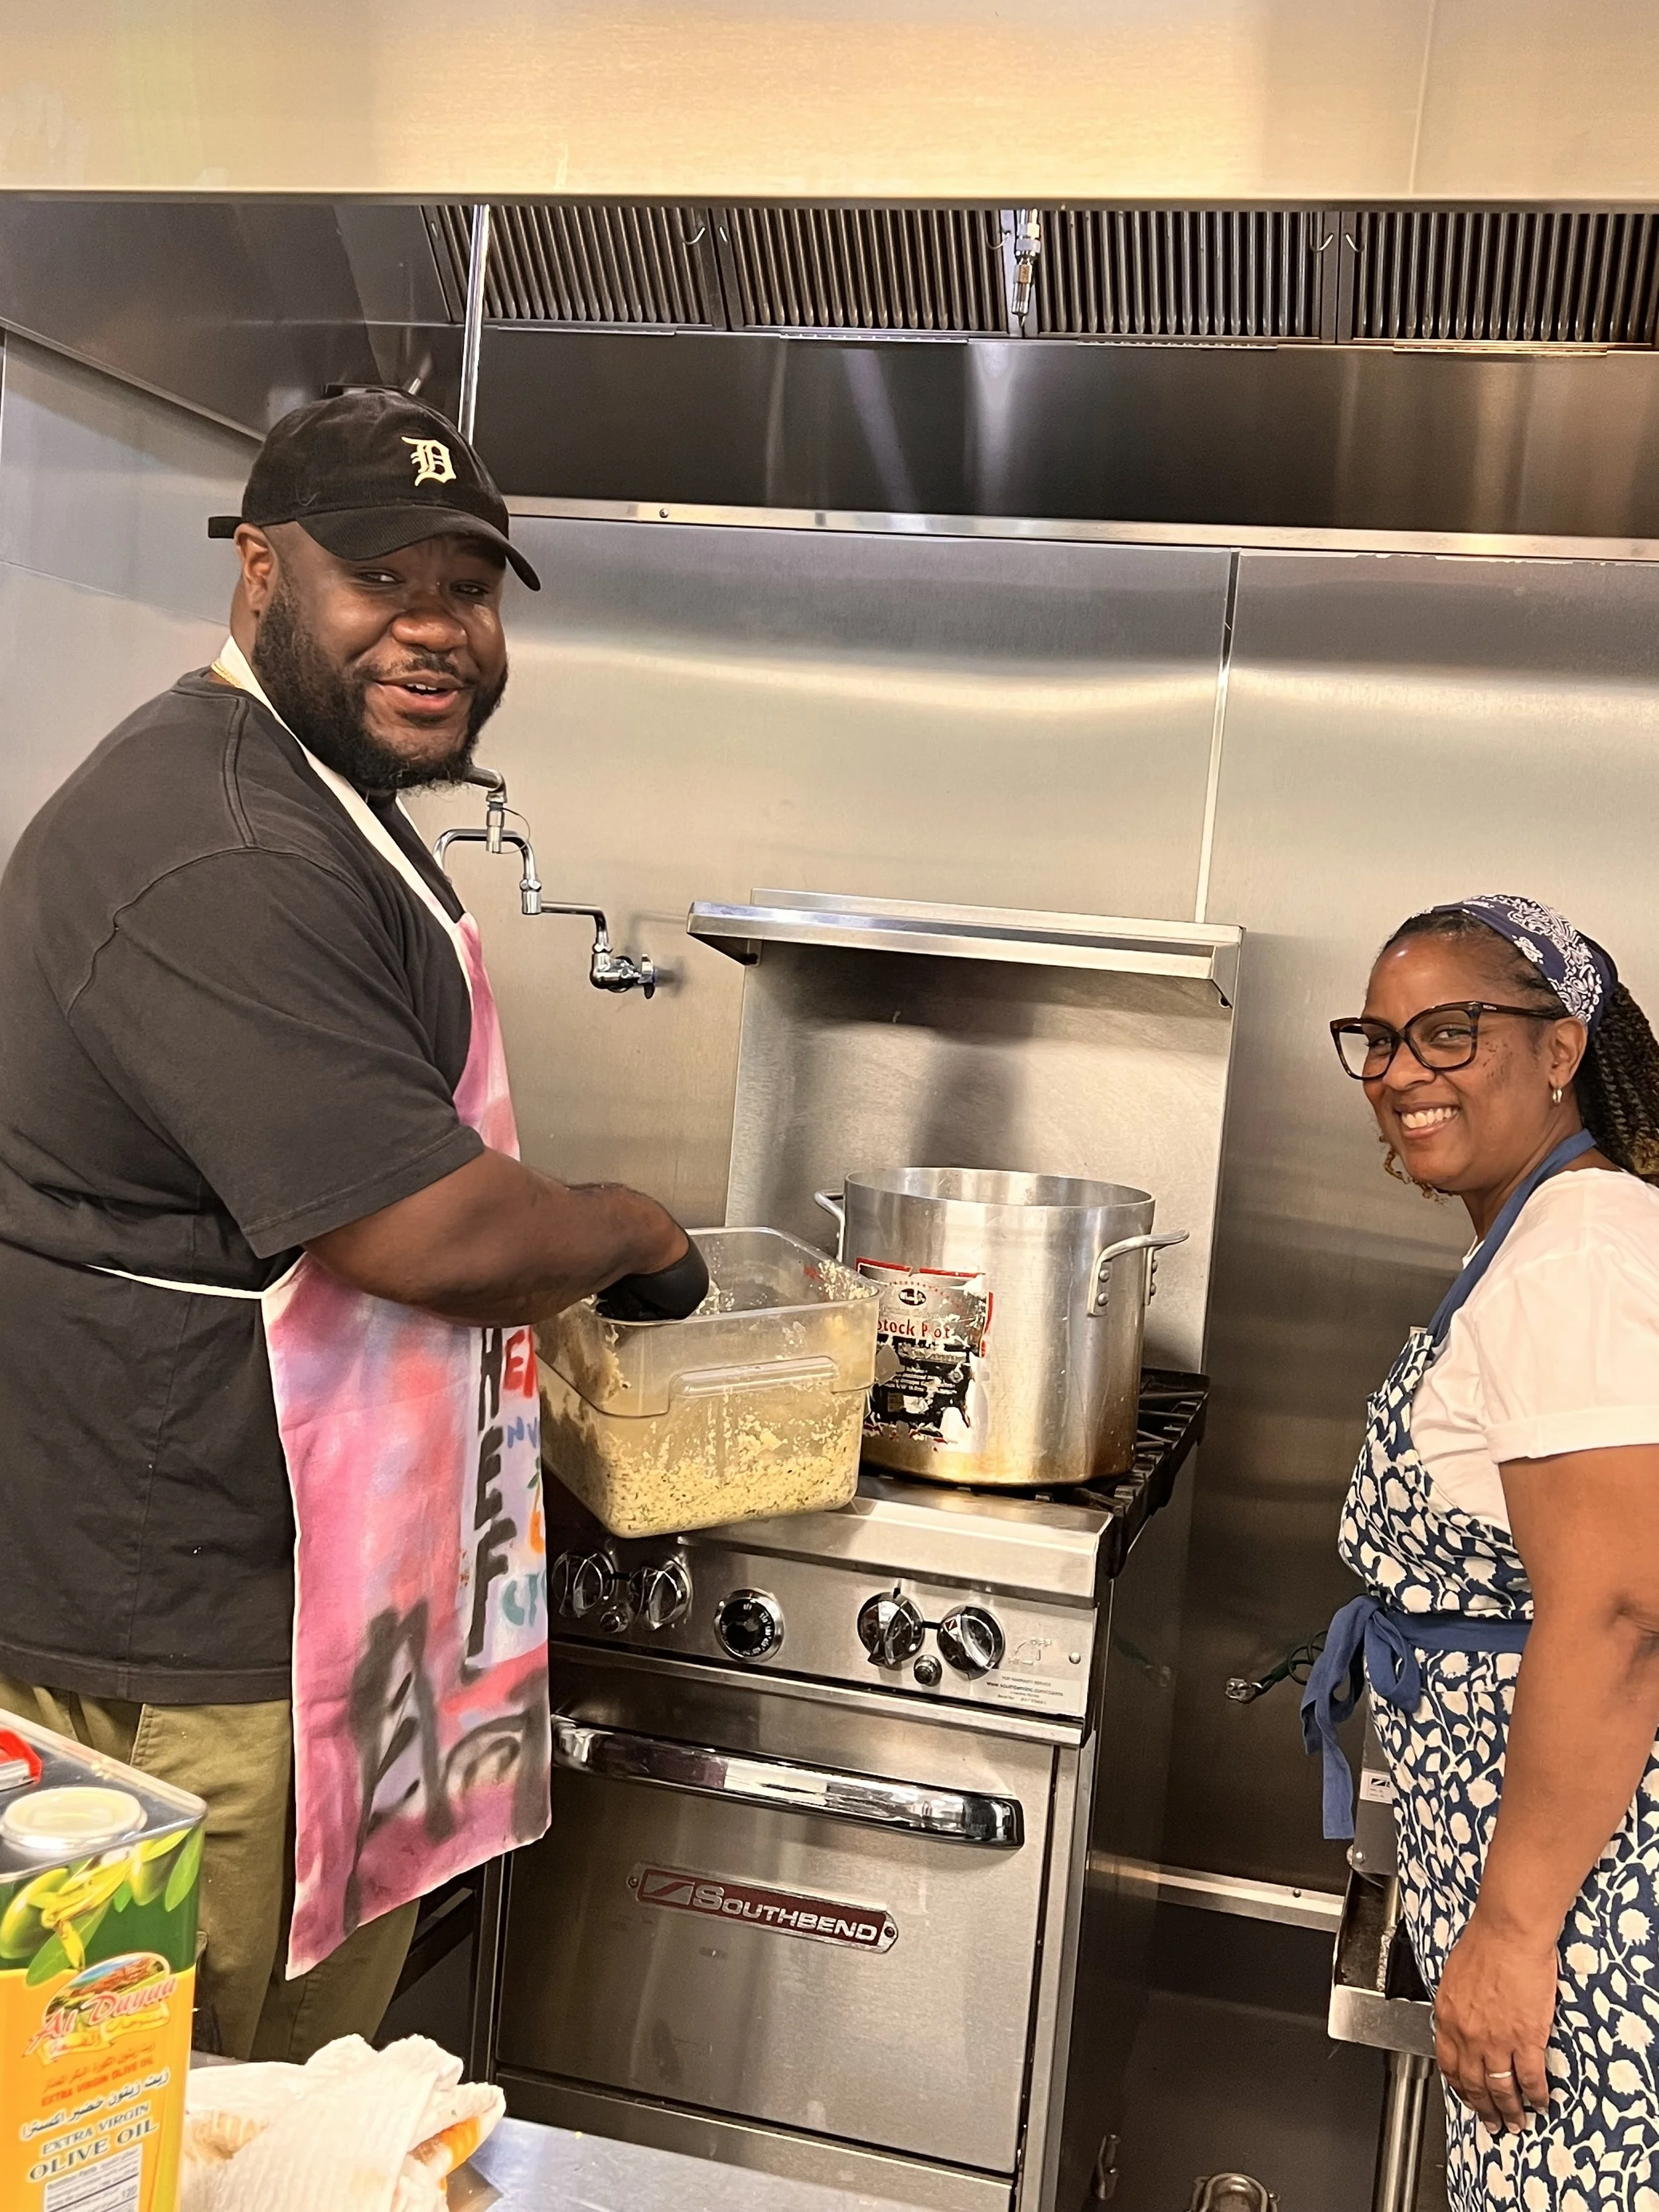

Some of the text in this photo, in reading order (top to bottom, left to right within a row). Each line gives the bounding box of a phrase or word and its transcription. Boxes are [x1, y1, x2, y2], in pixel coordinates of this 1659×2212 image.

[401, 436, 457, 486] D
[922, 1321, 950, 1339] Pot
[30, 2138, 109, 2179] OLIVE
[117, 2118, 158, 2144] OIL
[42, 2102, 149, 2155] EXTRA VIRGIN
